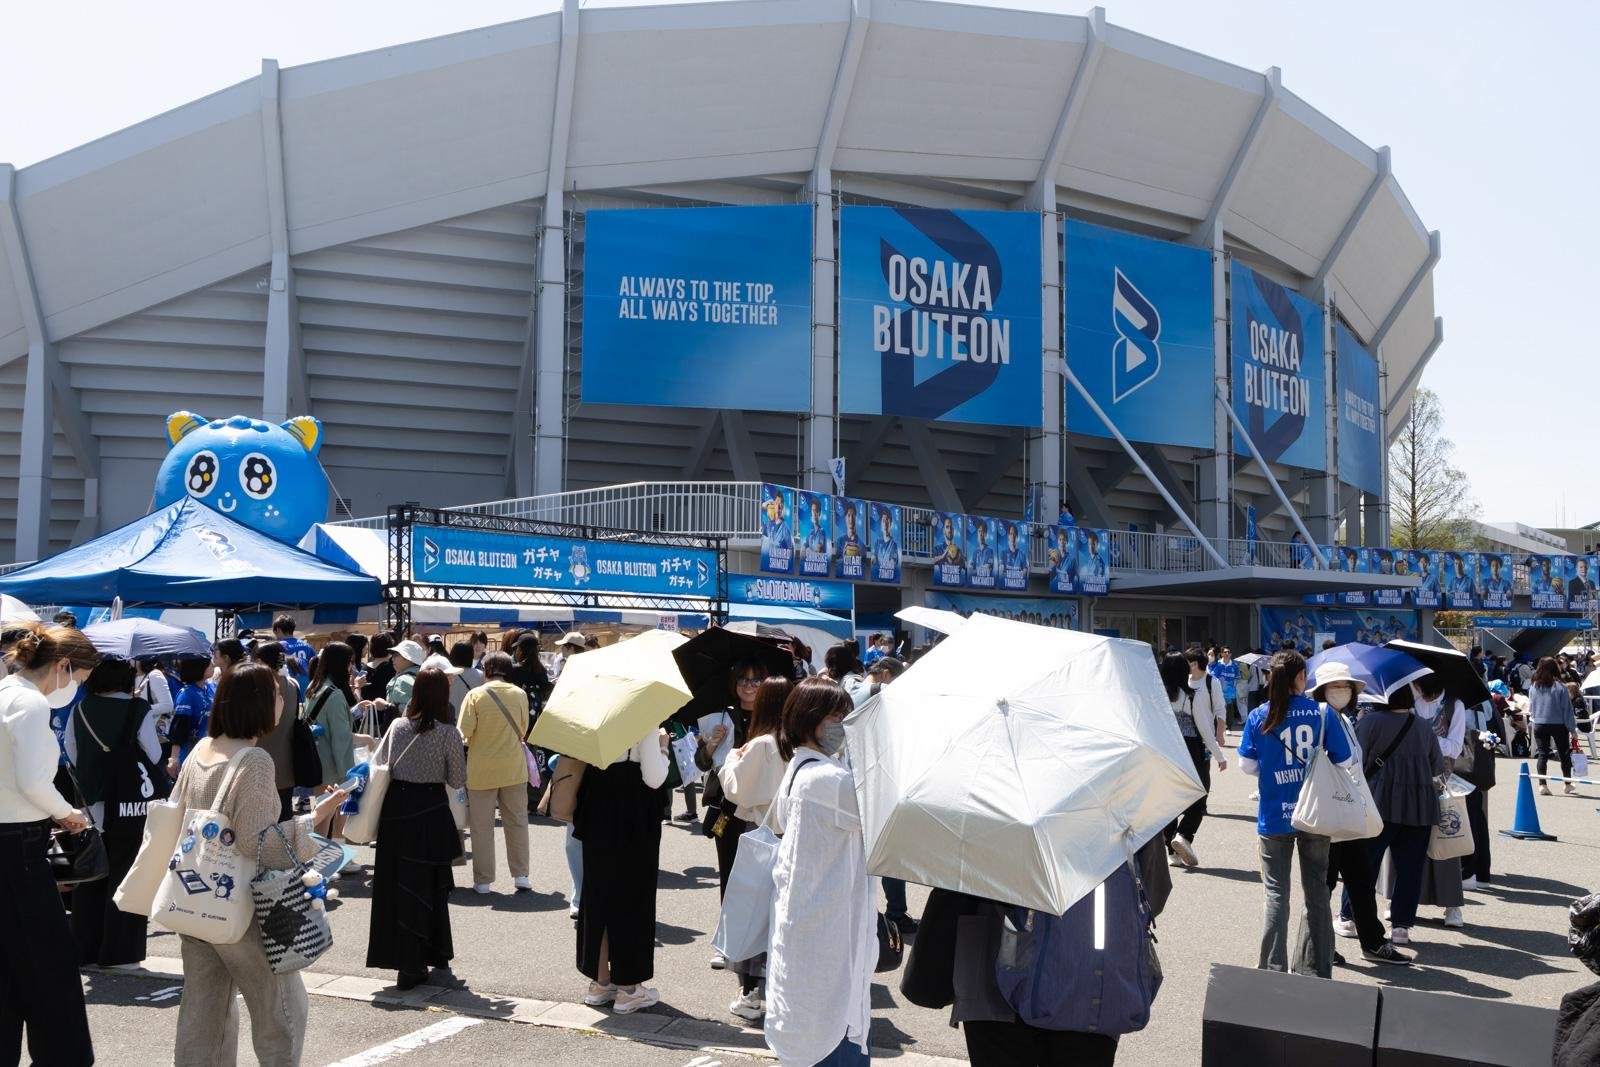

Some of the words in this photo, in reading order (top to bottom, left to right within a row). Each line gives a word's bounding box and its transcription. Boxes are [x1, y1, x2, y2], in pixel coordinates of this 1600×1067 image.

[619, 276, 685, 299] ALWAYS
[690, 280, 708, 300] TO
[713, 281, 741, 302] THE
[888, 254, 993, 312] OSAKA
[619, 298, 647, 319] ALL
[652, 299, 698, 322] WAYS
[703, 302, 778, 325] TOGETHER
[873, 305, 1010, 365] BLUTEON
[1250, 320, 1300, 372] OSAKA
[1244, 362, 1310, 418] BLUTEON
[445, 548, 476, 567] OSAKA
[478, 551, 517, 569] BLUTEON
[523, 546, 560, 565] ガチャ
[596, 559, 623, 575] OSAKA
[624, 561, 657, 577] BLUTEON
[661, 557, 691, 574] ガチャ
[533, 566, 562, 582] ガチャ
[669, 574, 694, 589] ガチャ
[1280, 724, 1315, 766] 18
